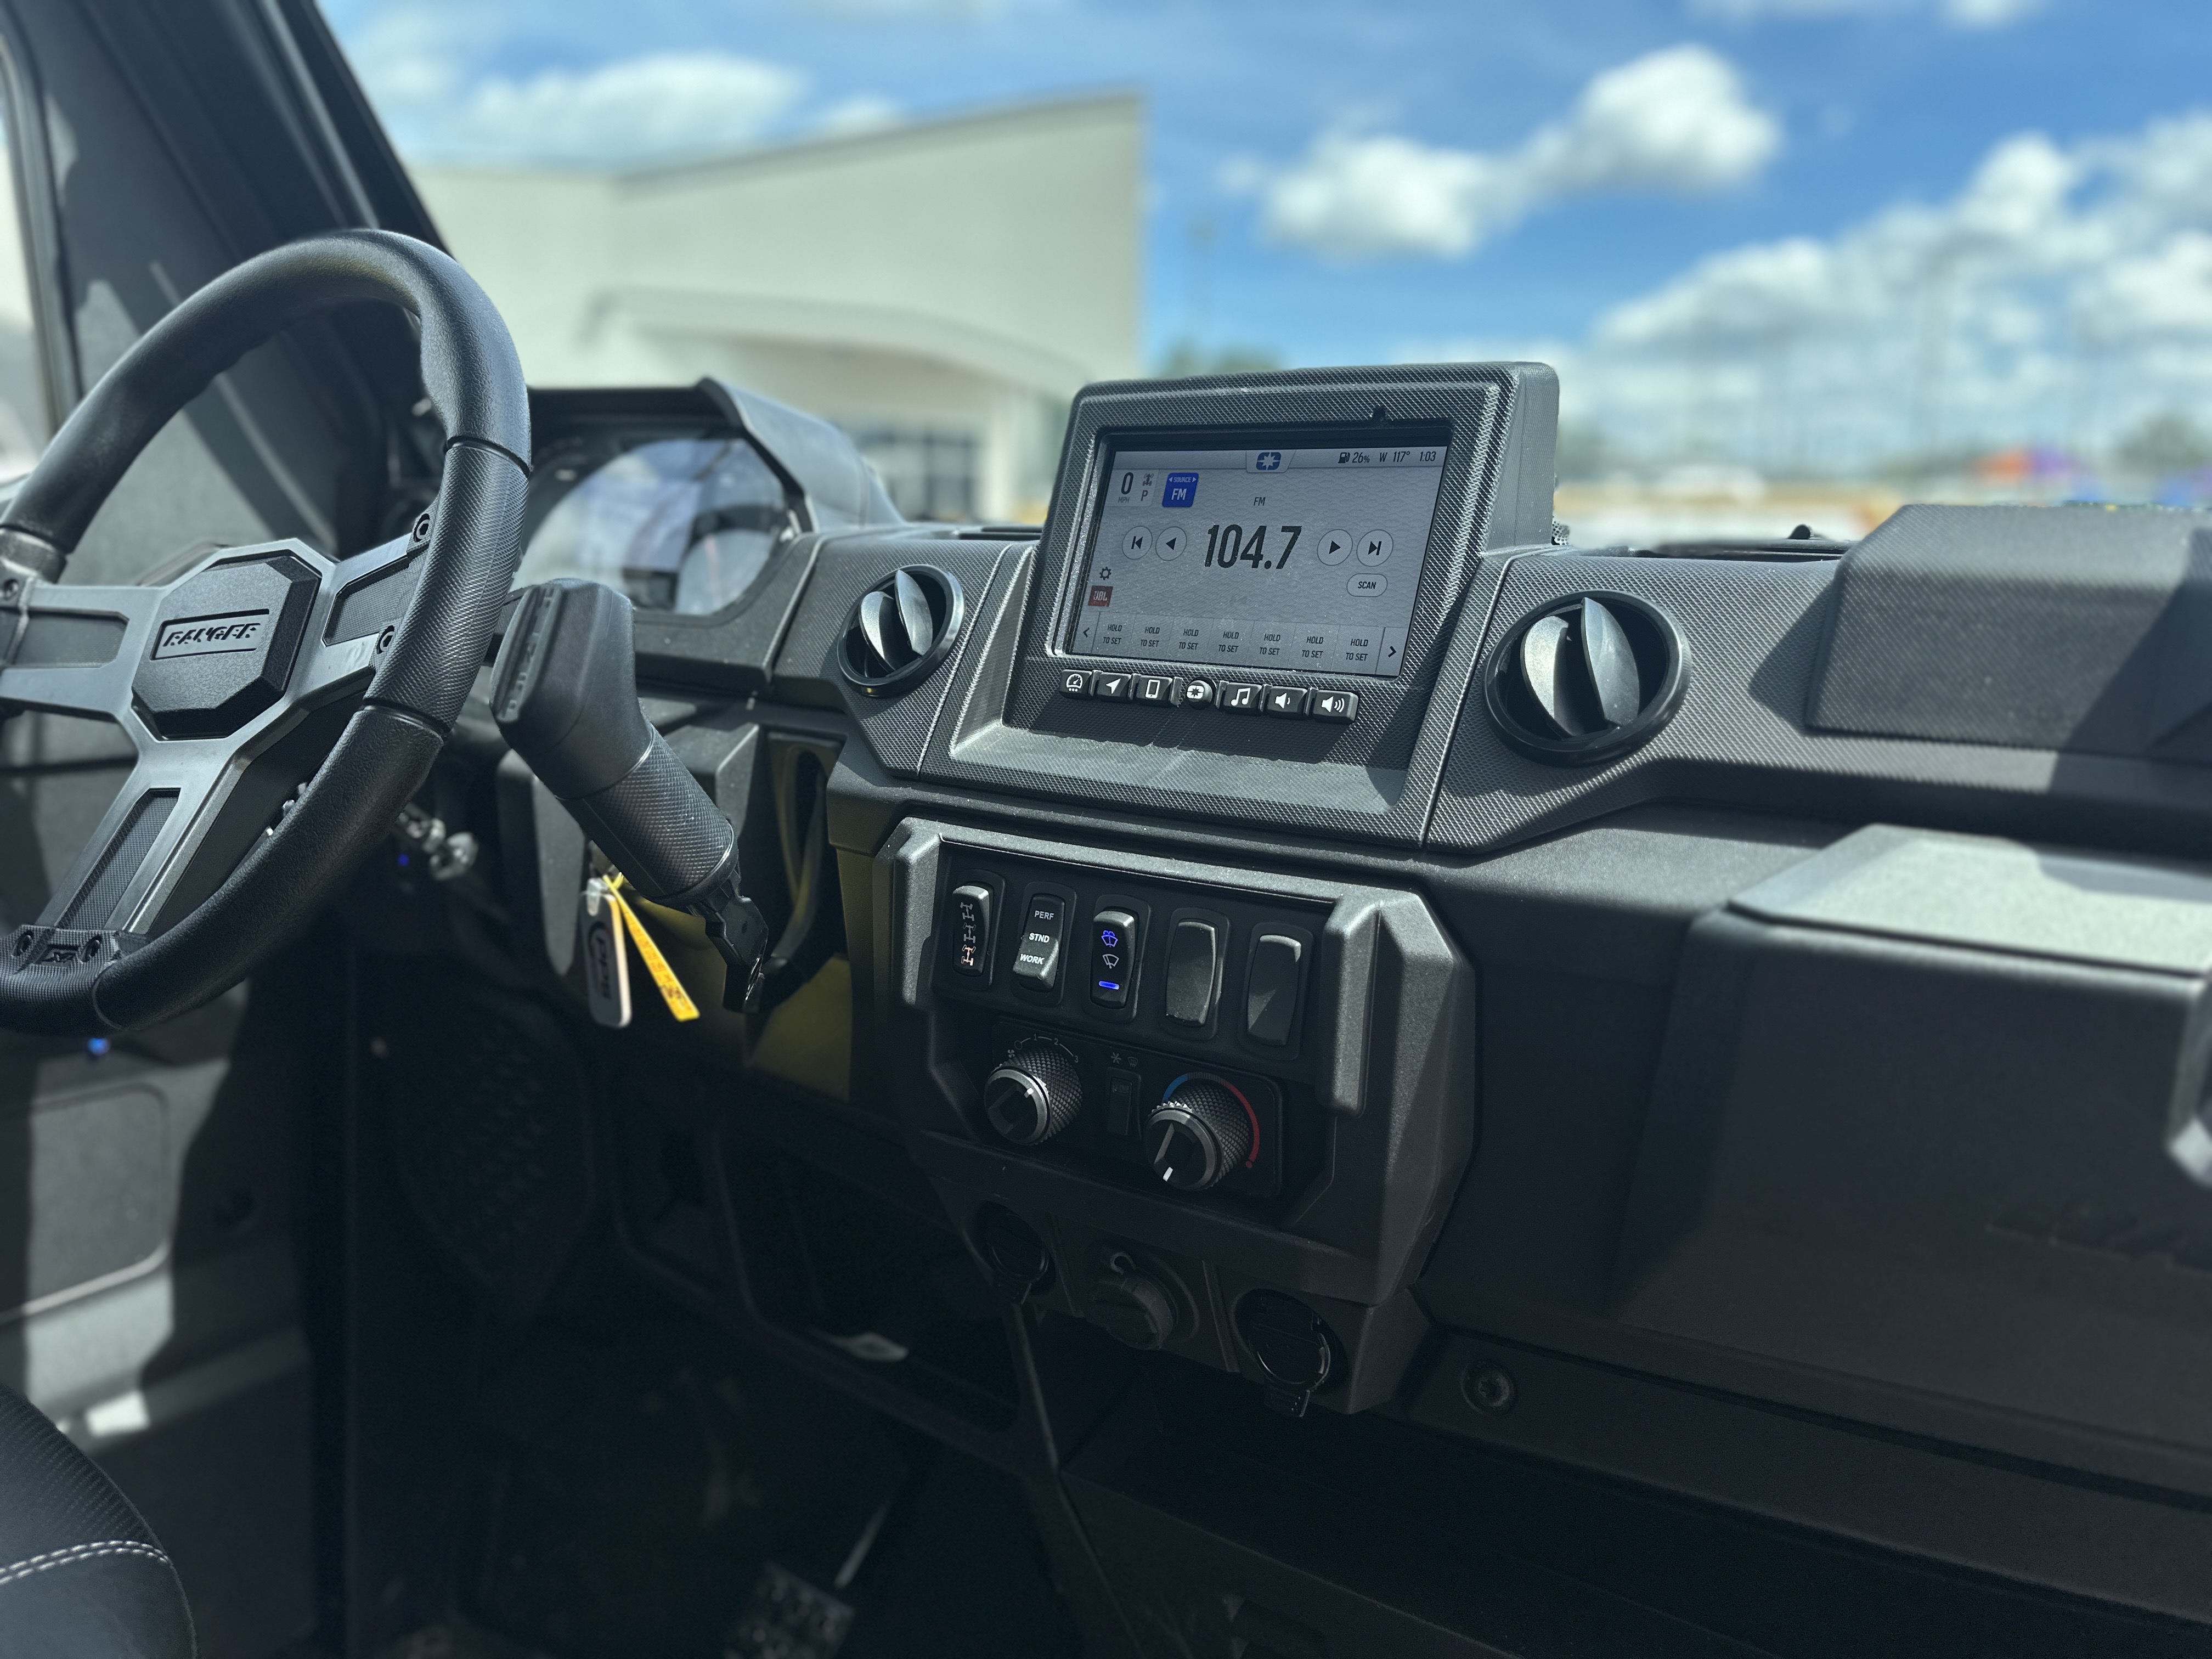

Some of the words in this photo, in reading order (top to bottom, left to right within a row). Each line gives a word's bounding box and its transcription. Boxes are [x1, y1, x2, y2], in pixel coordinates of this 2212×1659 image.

[1352, 452, 1370, 464] 26%
[1379, 452, 1388, 462] W
[1419, 450, 1437, 462] 1:03
[1121, 471, 1134, 495] 0
[1140, 489, 1148, 501] P
[1171, 488, 1187, 500] FM
[1253, 496, 1266, 506] FM
[1204, 524, 1302, 569] 104.7
[1357, 581, 1376, 589] SCAN
[1093, 590, 1108, 601] JBL
[162, 622, 262, 647] RANGER
[1223, 631, 1239, 639] HOLD
[1263, 634, 1281, 642] HOLD
[1306, 636, 1324, 644] HOLD
[1350, 638, 1368, 647] HOLD
[1268, 647, 1280, 656] SET
[1311, 650, 1323, 658] SET
[1346, 652, 1353, 661] TO
[1355, 653, 1368, 661] SET
[1034, 910, 1054, 920] PERF
[1029, 933, 1050, 943] STND
[1020, 953, 1045, 965] WORK
[1033, 1033, 1037, 1041] 1
[1074, 1055, 1079, 1063] 3
